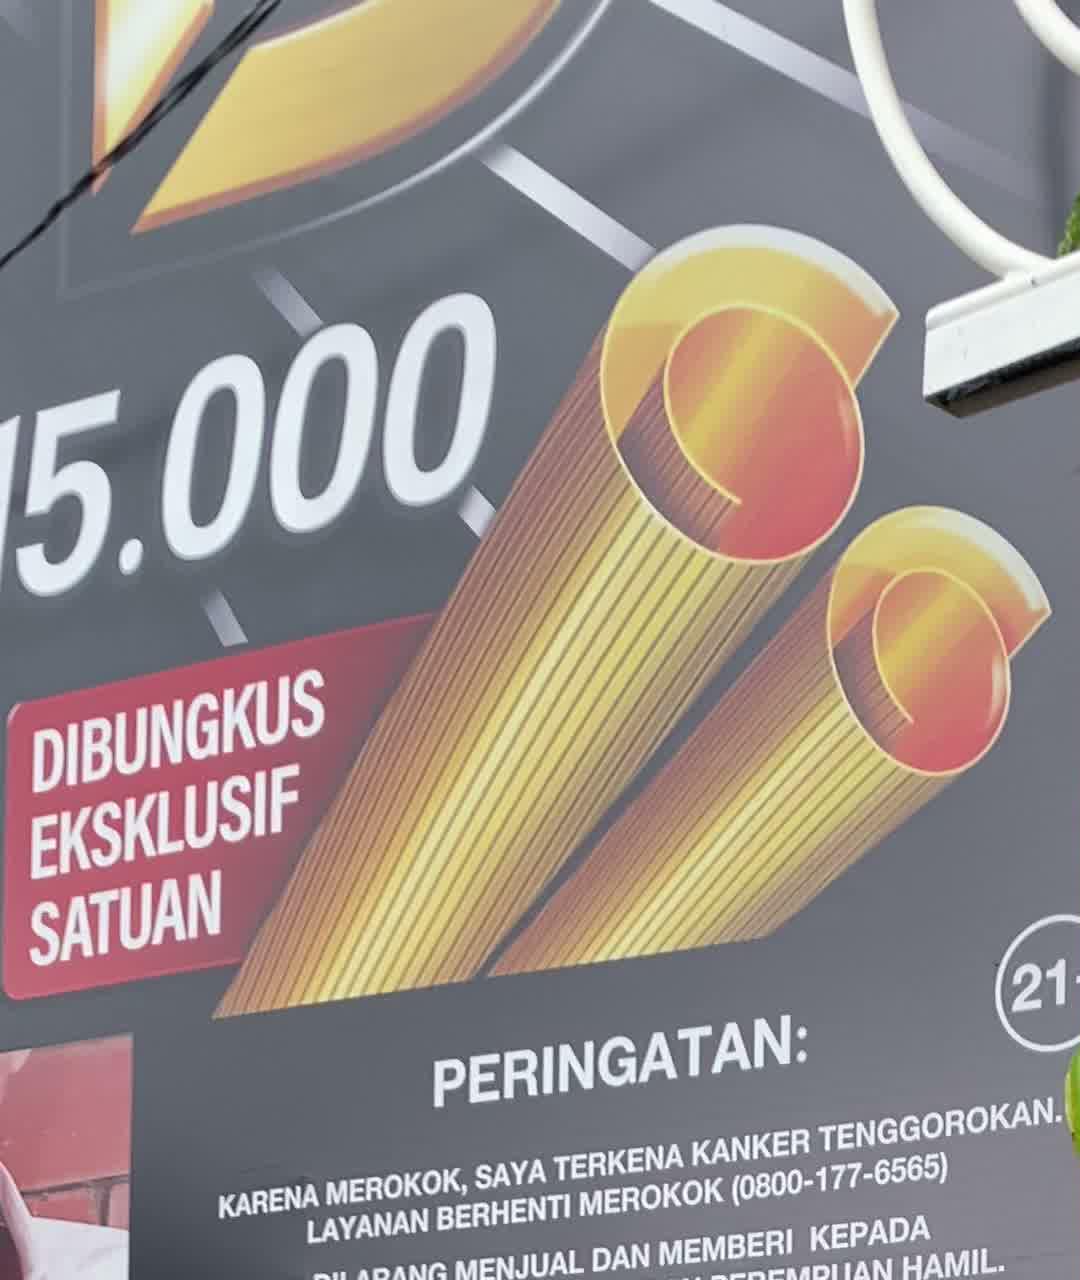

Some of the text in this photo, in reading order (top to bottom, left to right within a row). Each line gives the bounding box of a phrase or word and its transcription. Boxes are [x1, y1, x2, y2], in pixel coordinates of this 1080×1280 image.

[31, 668, 326, 794] DIBUNGKUS
[29, 763, 301, 880] EKSKLUSIF
[29, 869, 223, 967] SATUAN
[432, 1014, 809, 1108] PERINGATAN:
[218, 1096, 1064, 1220] KARENA MEROKOK, SAYA TERKENA KANKER TENGGOROKAN.
[306, 1151, 950, 1245] LAYANAN BERHENTI MEROKOK (0800-177-6565)
[591, 1242, 651, 1273] DAN
[658, 1228, 793, 1267] MEMBERI
[810, 1214, 932, 1252] KEPADA
